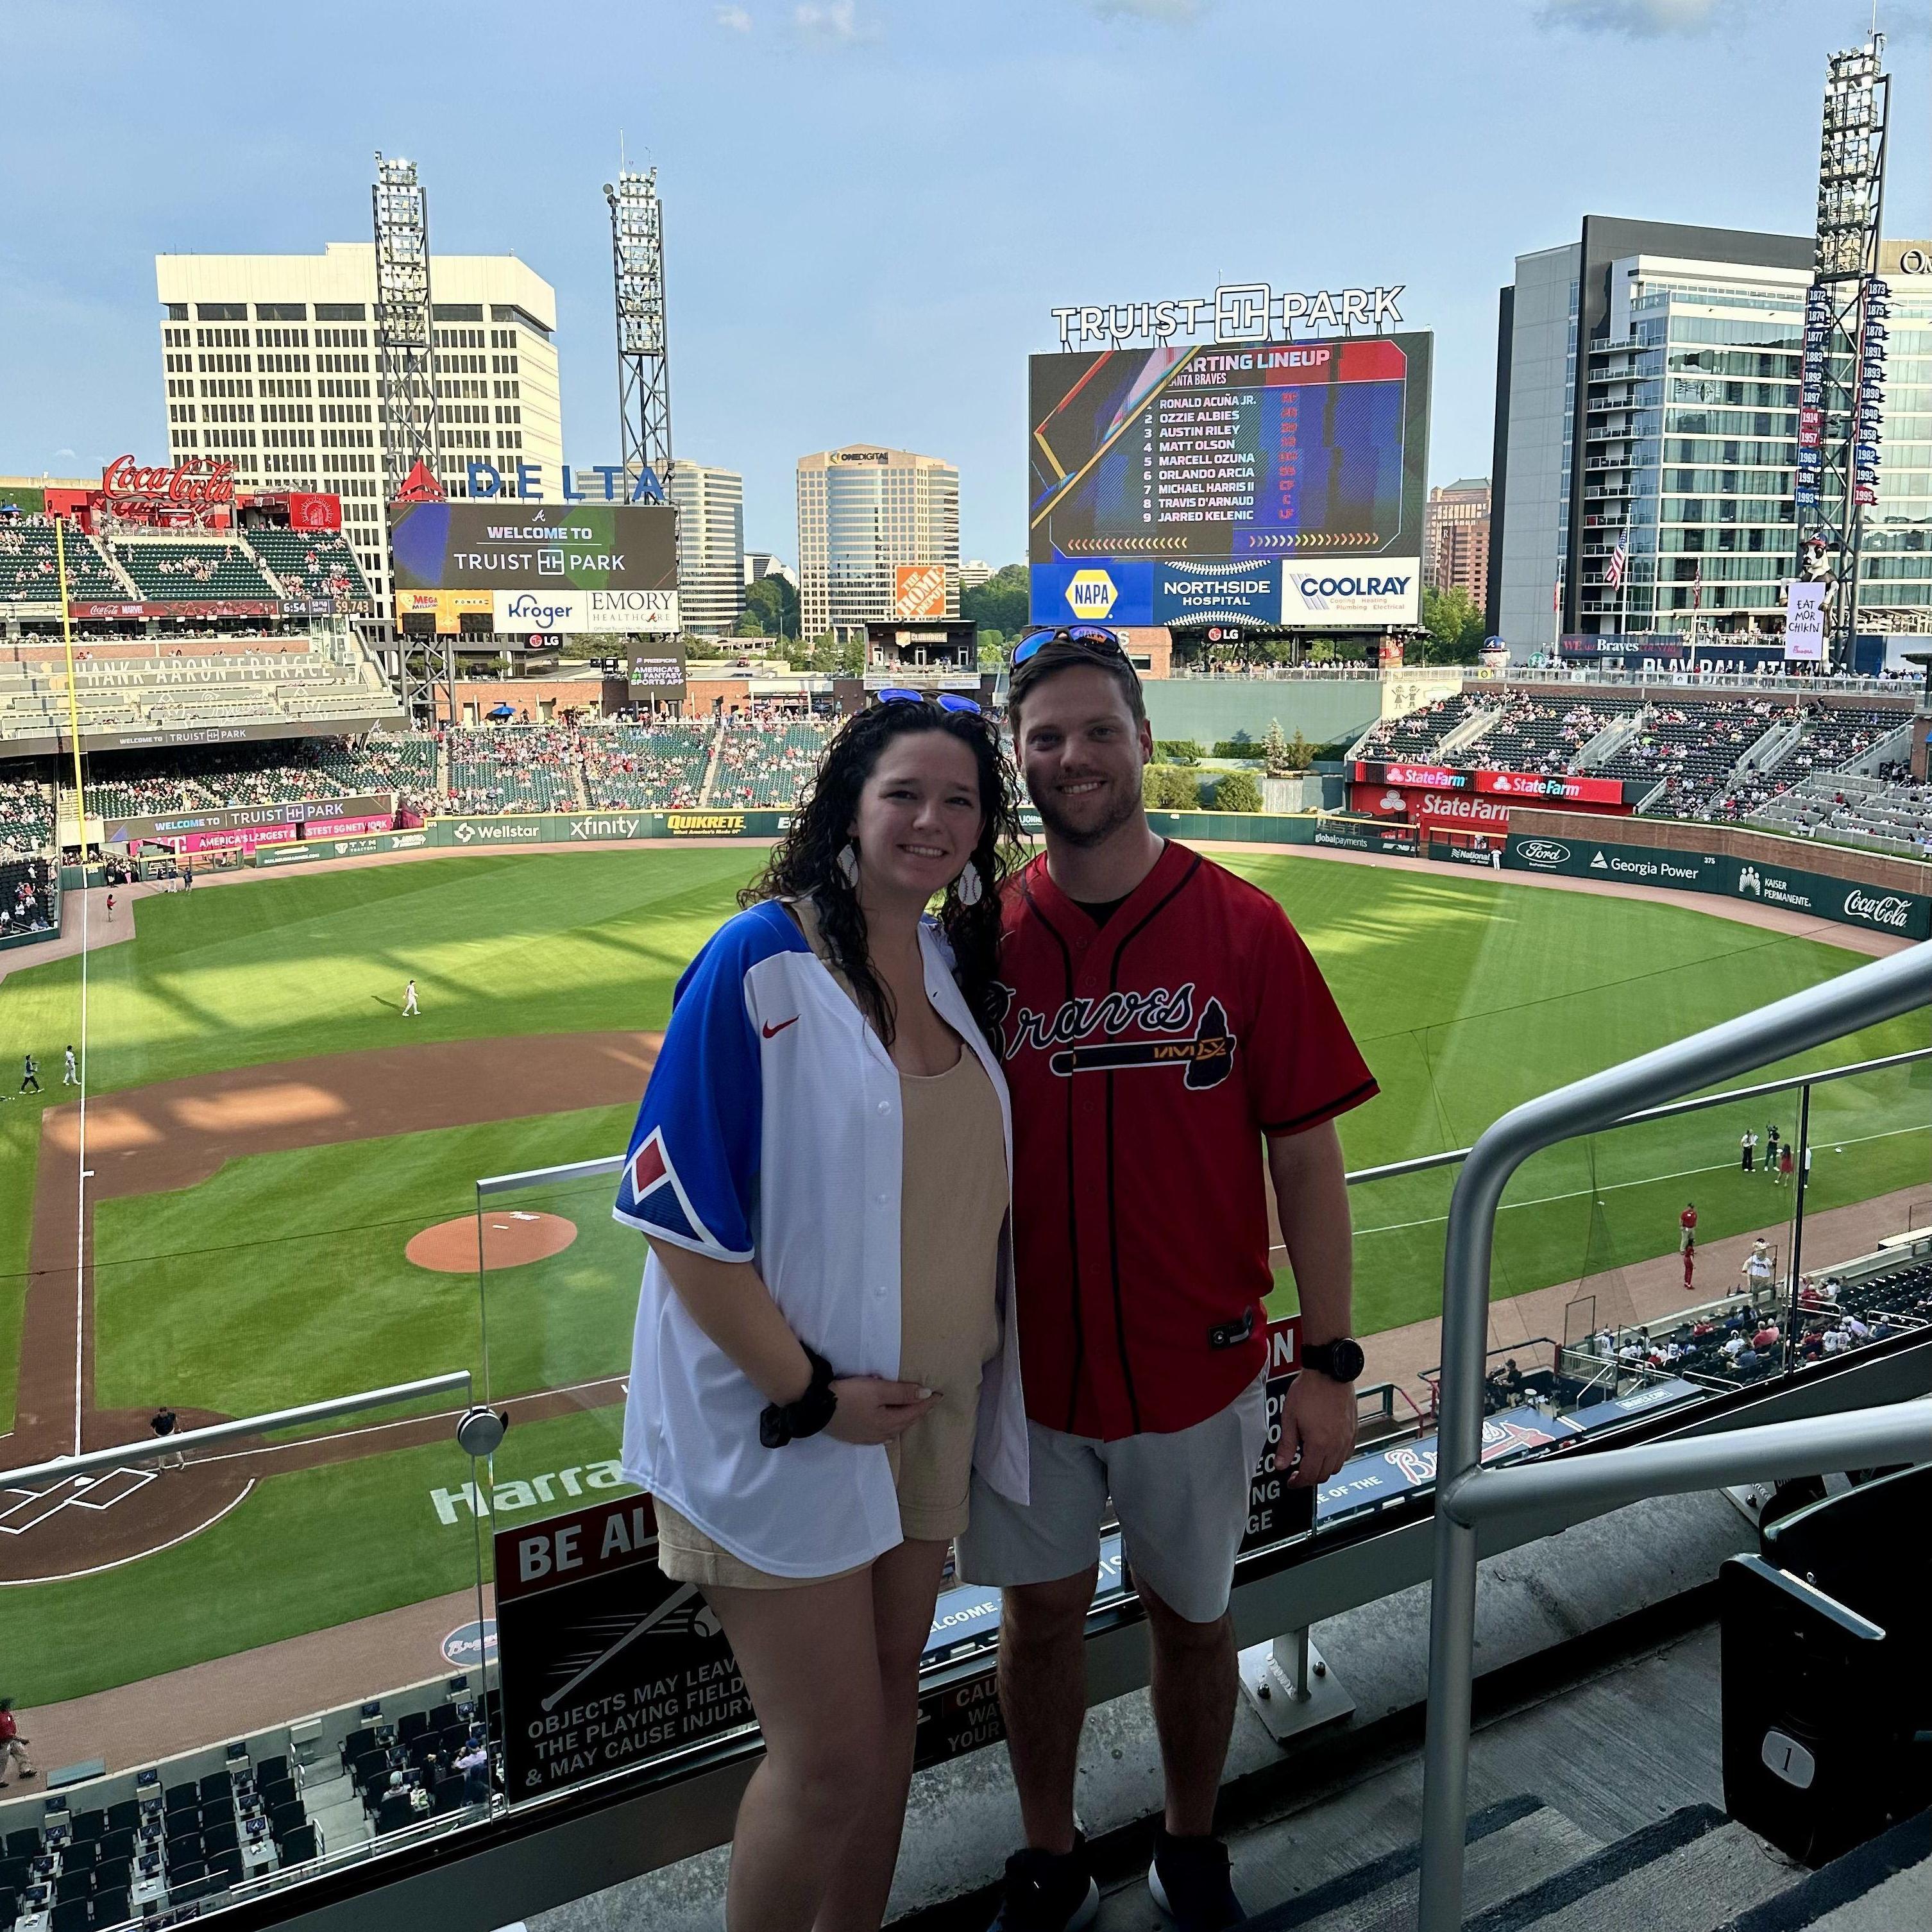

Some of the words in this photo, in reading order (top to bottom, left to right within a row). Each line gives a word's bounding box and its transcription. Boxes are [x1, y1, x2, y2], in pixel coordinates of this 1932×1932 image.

[1809, 290, 1826, 301] 1872
[1869, 284, 1885, 294] 1873
[1052, 300, 1204, 341] TRUIST
[1282, 285, 1405, 328] PARK
[1808, 311, 1825, 321] 1874
[1867, 305, 1885, 315] 1875
[1808, 332, 1823, 342] 1877
[1866, 325, 1883, 336] 1878
[1806, 352, 1823, 362] 1883
[1865, 346, 1881, 357] 1891
[1258, 350, 1330, 369] LINEUP
[1195, 372, 1226, 385] BRAVES
[1805, 372, 1822, 382] 1892
[1864, 367, 1881, 378] 1893
[1804, 392, 1820, 403] 1897
[1862, 387, 1879, 398] 1898
[1160, 398, 1201, 409] RONALD
[1203, 393, 1239, 407] ACUÑA
[1240, 395, 1257, 405] JR.
[1144, 414, 1152, 424] 2
[1160, 412, 1194, 423] OZZIE
[1197, 411, 1239, 421] ALBIES
[1802, 412, 1818, 423] 1914
[1861, 408, 1878, 419] 1948
[1144, 428, 1152, 438] 3
[1159, 427, 1203, 437] AUSTIN
[1205, 425, 1240, 436] RILEY
[1801, 432, 1818, 443] 1957
[1860, 429, 1876, 439] 1958
[1144, 443, 1152, 452] 4
[1159, 441, 1193, 452] MATT
[1195, 439, 1235, 450] OLSON
[1144, 457, 1152, 466] 5
[1159, 455, 1212, 466] MARCELL
[1214, 453, 1255, 464] OZUNA
[1800, 452, 1817, 463] 1969
[1858, 449, 1875, 460] 1982
[1144, 471, 1151, 480] 6
[1159, 469, 1216, 480] ORLANDO
[1217, 468, 1255, 478] ARCIA
[1799, 472, 1814, 483] 1991
[1856, 470, 1874, 480] 1992
[467, 462, 665, 500] DELTA
[1144, 485, 1151, 494] 7
[1158, 484, 1205, 494] MICHAEL
[1207, 482, 1246, 493] HARRIS
[1248, 482, 1254, 491] II
[1797, 492, 1814, 503] 1993
[1856, 490, 1872, 501] 1995
[1144, 499, 1151, 509] 8
[1158, 498, 1196, 508] TRAVIS
[1198, 496, 1254, 507] D'ARNAUD
[1143, 513, 1151, 522] 9
[1158, 512, 1203, 522] JARRED
[1205, 511, 1253, 521] KELENIC
[487, 527, 568, 539] WELCOME
[571, 527, 592, 539] TO
[453, 554, 532, 571] TRUIST
[570, 555, 625, 571] PARK
[901, 572, 922, 591] THE
[1164, 580, 1271, 595] NORTHSIDE
[1300, 576, 1412, 597] COOLRAY
[897, 566, 945, 615] HOME
[1074, 584, 1108, 604] NAPA
[413, 595, 438, 604] MEGA
[591, 592, 674, 609] EMORY
[915, 584, 945, 615] DEPOT
[1183, 597, 1250, 606] HOSPITAL
[1797, 599, 1815, 609] EAT
[122, 605, 144, 614] MARVEL
[284, 602, 306, 613] 6:54
[335, 600, 369, 614] $9,743
[508, 594, 573, 629] Kroger
[593, 613, 671, 622] HEALTHCARE
[1794, 610, 1815, 620] MOR
[1788, 623, 1820, 632] CHIKIN
[544, 636, 559, 646] LG
[1222, 630, 1239, 640] LG
[1563, 641, 1582, 651] WE
[1597, 639, 1640, 652] Braves
[76, 660, 144, 686] HANK
[145, 658, 226, 683] AARON
[224, 655, 330, 680] TERRACE
[170, 731, 205, 742] TRUIST
[221, 729, 246, 739] PARK
[155, 820, 205, 832] WELCOME
[206, 817, 220, 826] TO
[231, 809, 283, 825] TRUIST
[307, 803, 344, 818] PARK
[667, 815, 744, 829] QUIKRETE
[478, 825, 539, 839] Wellstar
[570, 816, 640, 840] xfinity
[199, 835, 248, 848] AMERICA'S
[248, 830, 288, 842] LARGEST
[289, 829, 297, 838] &
[334, 824, 345, 834] 5G
[1315, 833, 1368, 847] globalpayments
[1460, 851, 1491, 861] National
[1526, 843, 1561, 860] Ford
[1611, 858, 1659, 877] Georgia
[1661, 863, 1699, 880] Power
[1765, 877, 1787, 890] KAISER
[1764, 889, 1810, 906] PERMANENTE
[430, 1457, 625, 1525] Harra
[1328, 1484, 1349, 1498] OF
[1349, 1476, 1384, 1491] THE
[518, 1525, 584, 1582] BE
[929, 1602, 999, 1634] ELCOME
[528, 1693, 625, 1739] OBJECTS
[634, 1675, 679, 1704] MAY
[686, 1657, 737, 1687] LEAV
[535, 1734, 579, 1760] THE
[586, 1699, 679, 1743] PLAYING
[686, 1676, 745, 1709] FIELD
[525, 1768, 542, 1786] &
[550, 1749, 597, 1780] MAY
[605, 1725, 676, 1759] CAUSE
[682, 1696, 754, 1732] INJURY
[947, 1722, 1000, 1752] YOUR
[1781, 1746, 1793, 1773] 1
